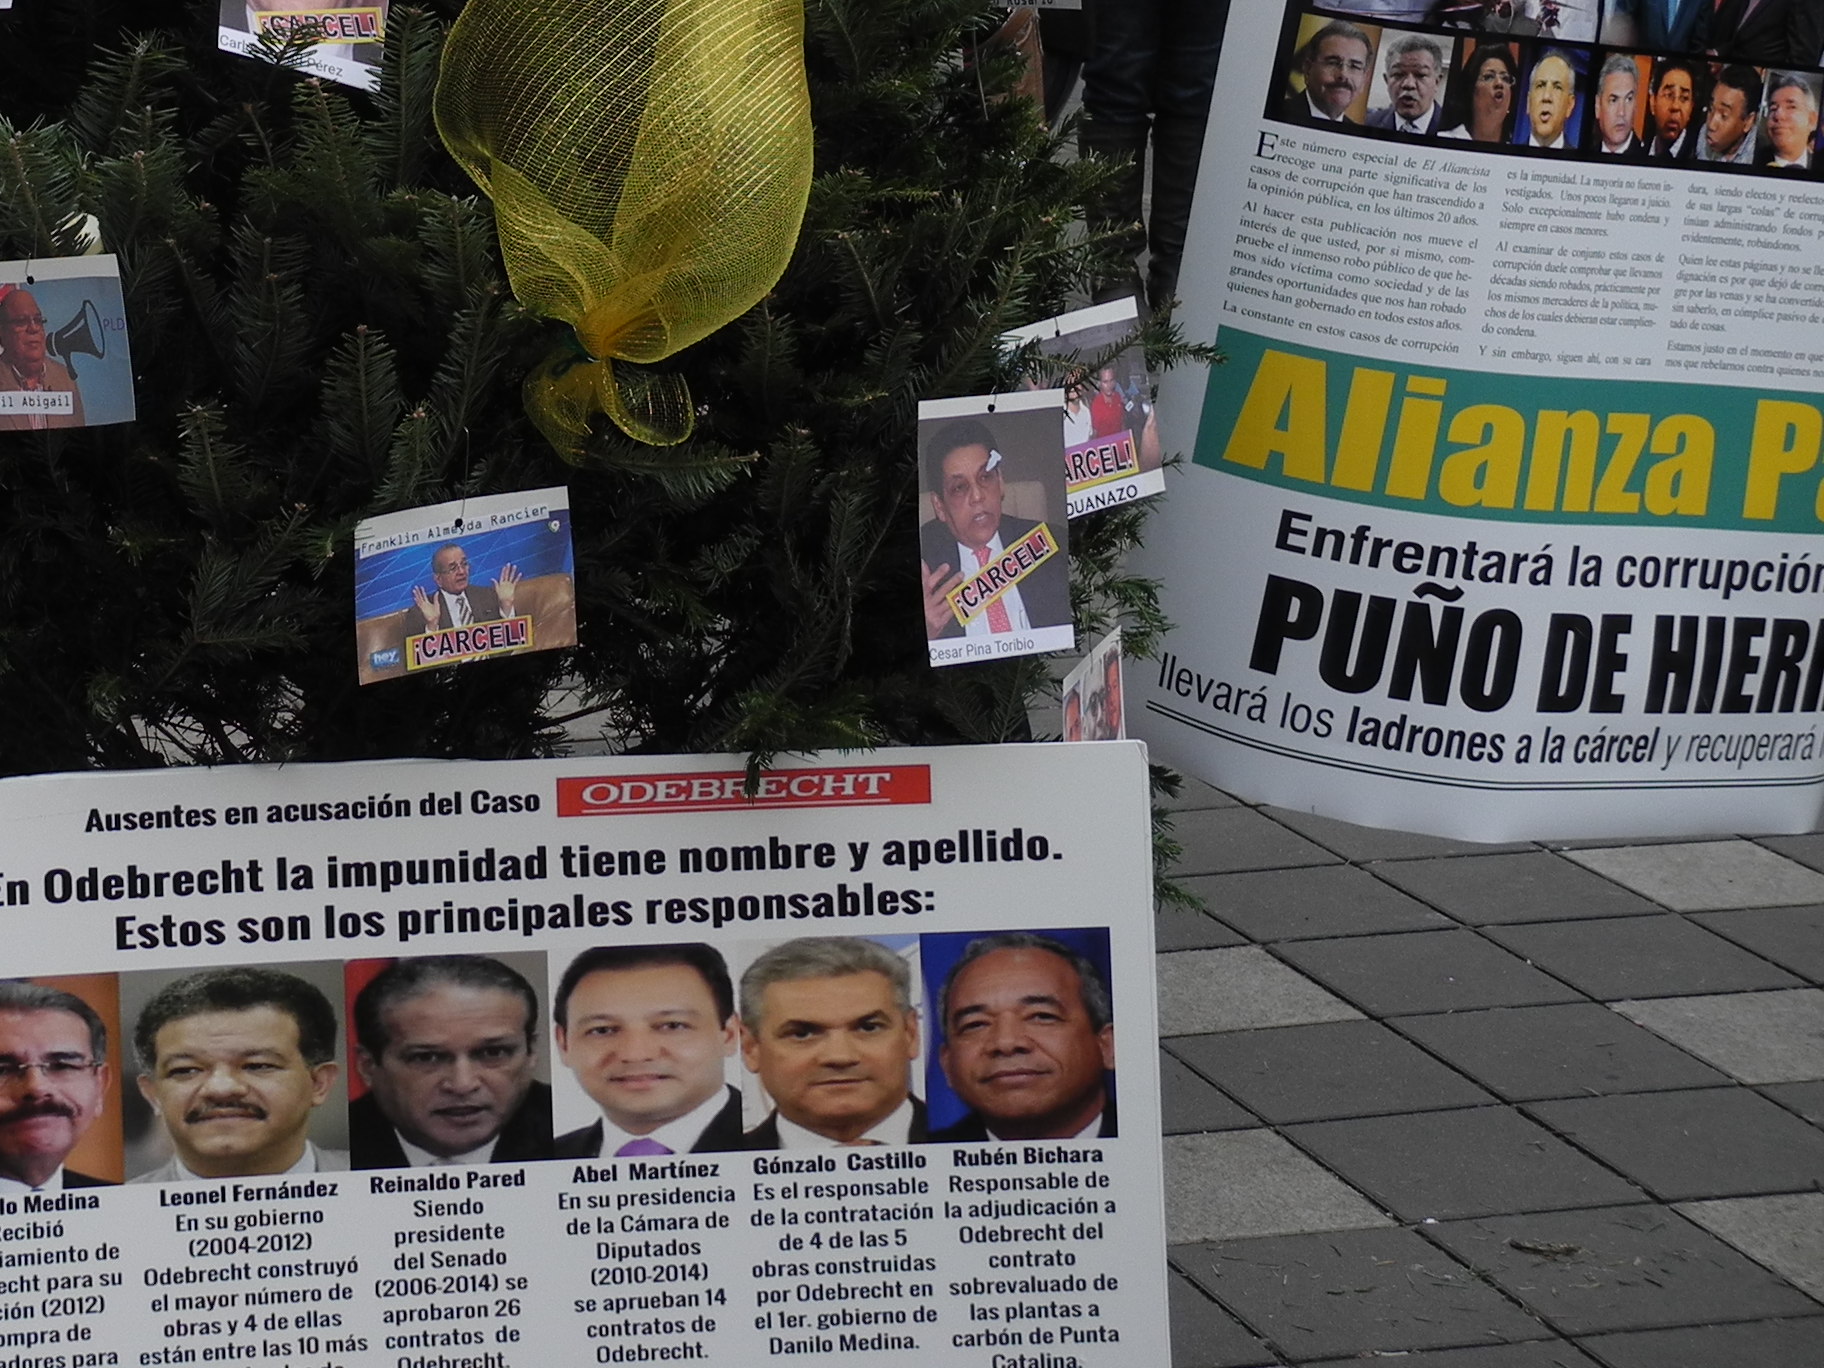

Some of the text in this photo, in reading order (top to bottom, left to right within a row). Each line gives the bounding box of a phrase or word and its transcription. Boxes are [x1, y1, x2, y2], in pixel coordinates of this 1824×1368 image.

[103, 317, 125, 331] PLD
[21, 393, 71, 408] Abigail
[1222, 348, 1716, 516] Alianza
[361, 504, 547, 553] Franklin Almeyda Rancier
[1275, 509, 1602, 588] Enfrentará la
[955, 534, 1051, 618] ¡CARCEL!
[414, 622, 526, 667] ¡CARCEL!
[929, 645, 962, 662] Cesar
[994, 637, 1035, 655] Toribio
[1249, 573, 1633, 714] PUÑO DE
[1158, 652, 1817, 771] llevará los ladrones a la cárcel y recuperará
[84, 805, 217, 833] Ausentes
[224, 804, 258, 826] en
[266, 791, 412, 825] acusación
[419, 789, 463, 817] del
[471, 786, 540, 815] Caso
[44, 859, 264, 905] Odebrecht
[276, 856, 314, 891] la
[327, 846, 547, 893] impunidad
[561, 840, 666, 879] tiene
[679, 836, 837, 875] nombre
[849, 839, 870, 872] y
[882, 828, 1063, 870] apellido.
[115, 882, 935, 950] Estos son los principales responsables:
[572, 1161, 720, 1184] Abel Martínez
[753, 1151, 927, 1176] Gónzalo Castillo
[953, 1146, 1104, 1168] Rubén Bichara
[23, 1194, 100, 1214] Medina
[160, 1181, 339, 1208] Leonel Fernández
[370, 1169, 526, 1194] Reinaldo Pared
